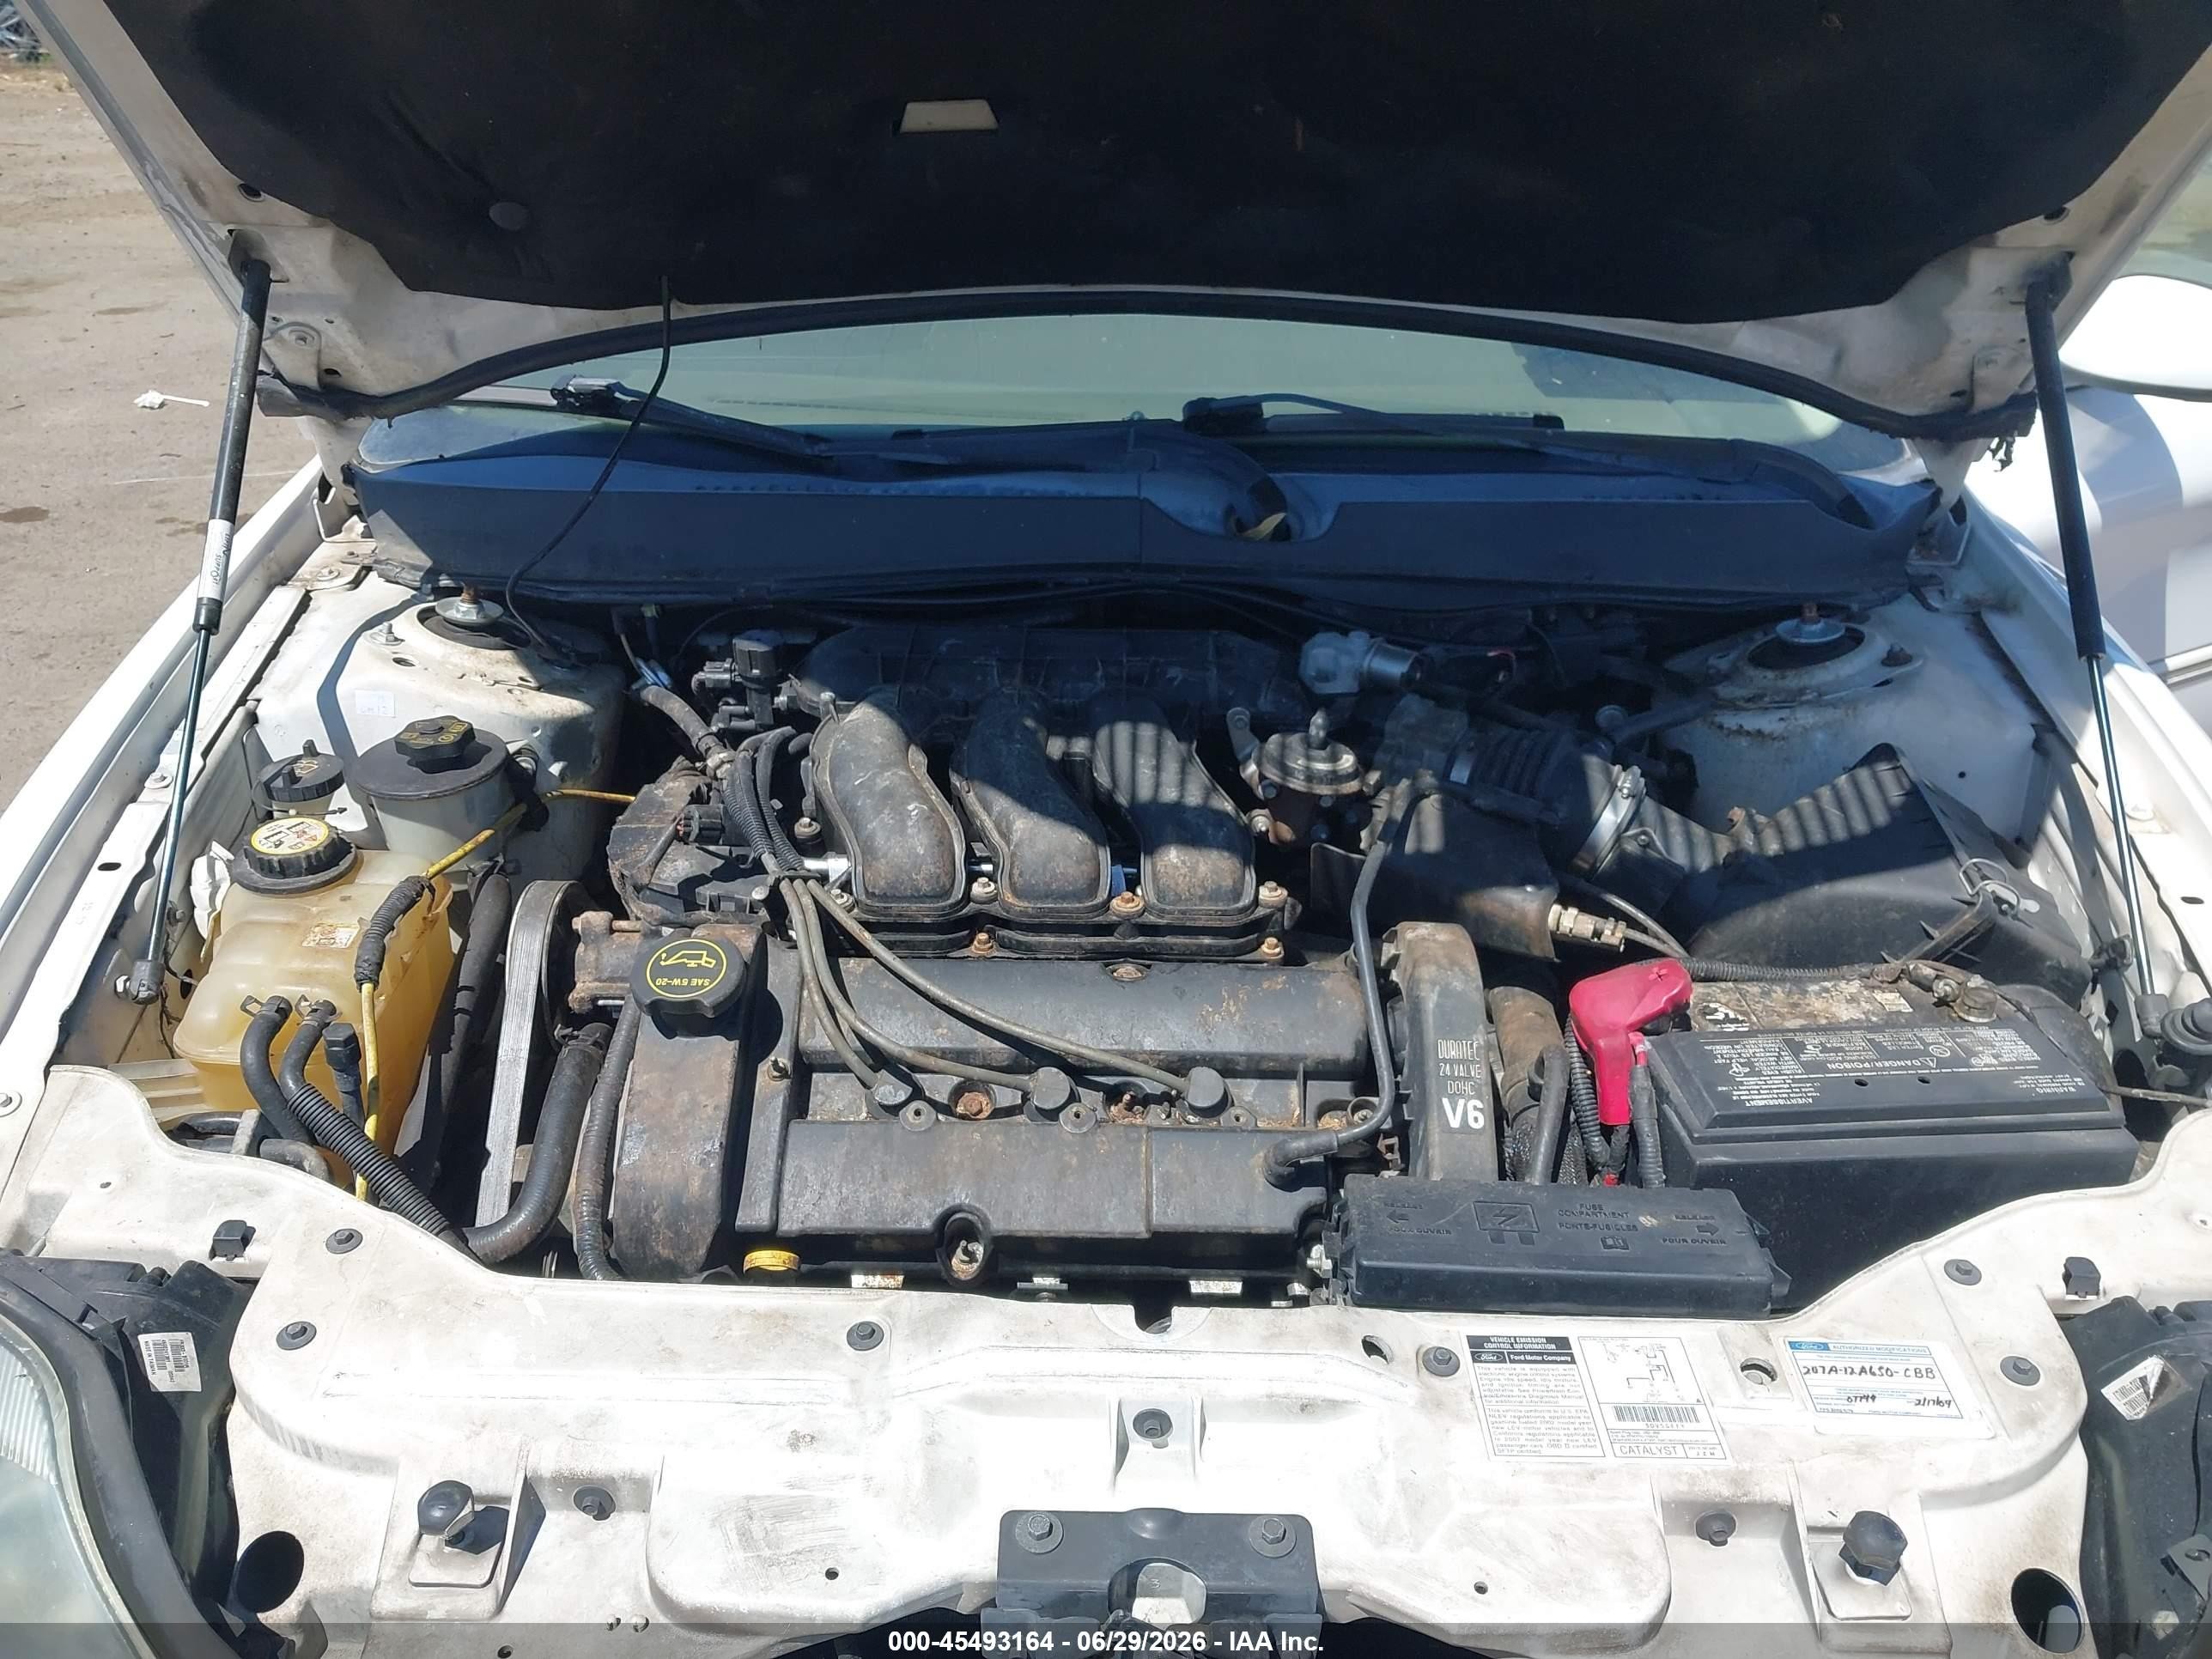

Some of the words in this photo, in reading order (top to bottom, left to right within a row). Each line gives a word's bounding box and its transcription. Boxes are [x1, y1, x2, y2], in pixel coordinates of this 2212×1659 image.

[655, 977, 689, 987] 5W-20
[690, 978, 711, 987] SAE
[1437, 1039, 1480, 1060] DURATEC
[1826, 1059, 1922, 1069] DANGER/POISON
[1439, 1063, 1450, 1077] 24
[1453, 1064, 1481, 1079] VALVE
[1447, 1080, 1475, 1095] DOHC
[1745, 1097, 1813, 1106] AVERTISSEMENT
[1442, 1097, 1485, 1129] V6
[1579, 1202, 1604, 1211] FUSE
[1558, 1208, 1629, 1218] COMPARTMENT
[1543, 1354, 1571, 1363] Company
[1620, 1445, 1678, 1455] CATALYST
